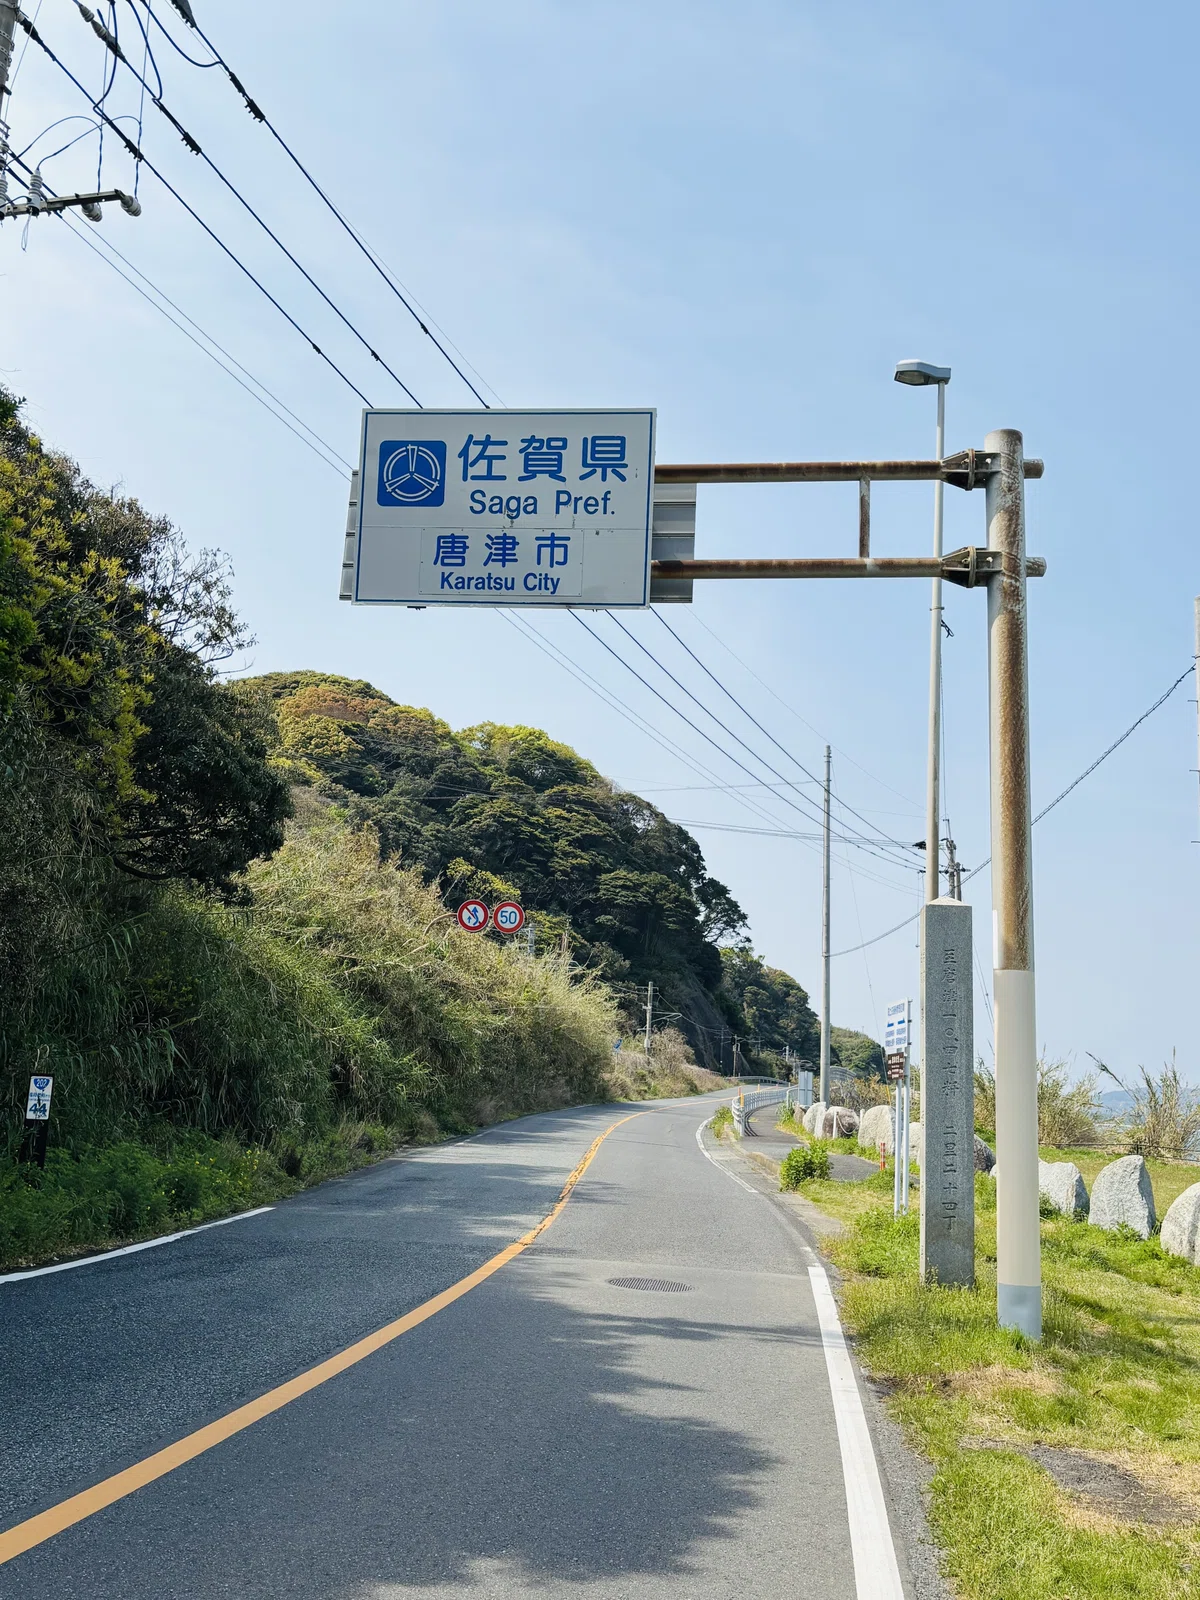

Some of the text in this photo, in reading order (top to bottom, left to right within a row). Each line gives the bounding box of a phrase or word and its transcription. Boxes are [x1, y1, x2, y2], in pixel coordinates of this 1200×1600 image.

[457, 433, 628, 483] 佐賀県
[469, 489, 615, 519] Saga Pref.
[433, 532, 571, 568] 唐津市
[440, 572, 560, 595] Karatsu City
[500, 910, 517, 924] 50
[36, 1078, 47, 1087] 202
[29, 1103, 47, 1115] 44
